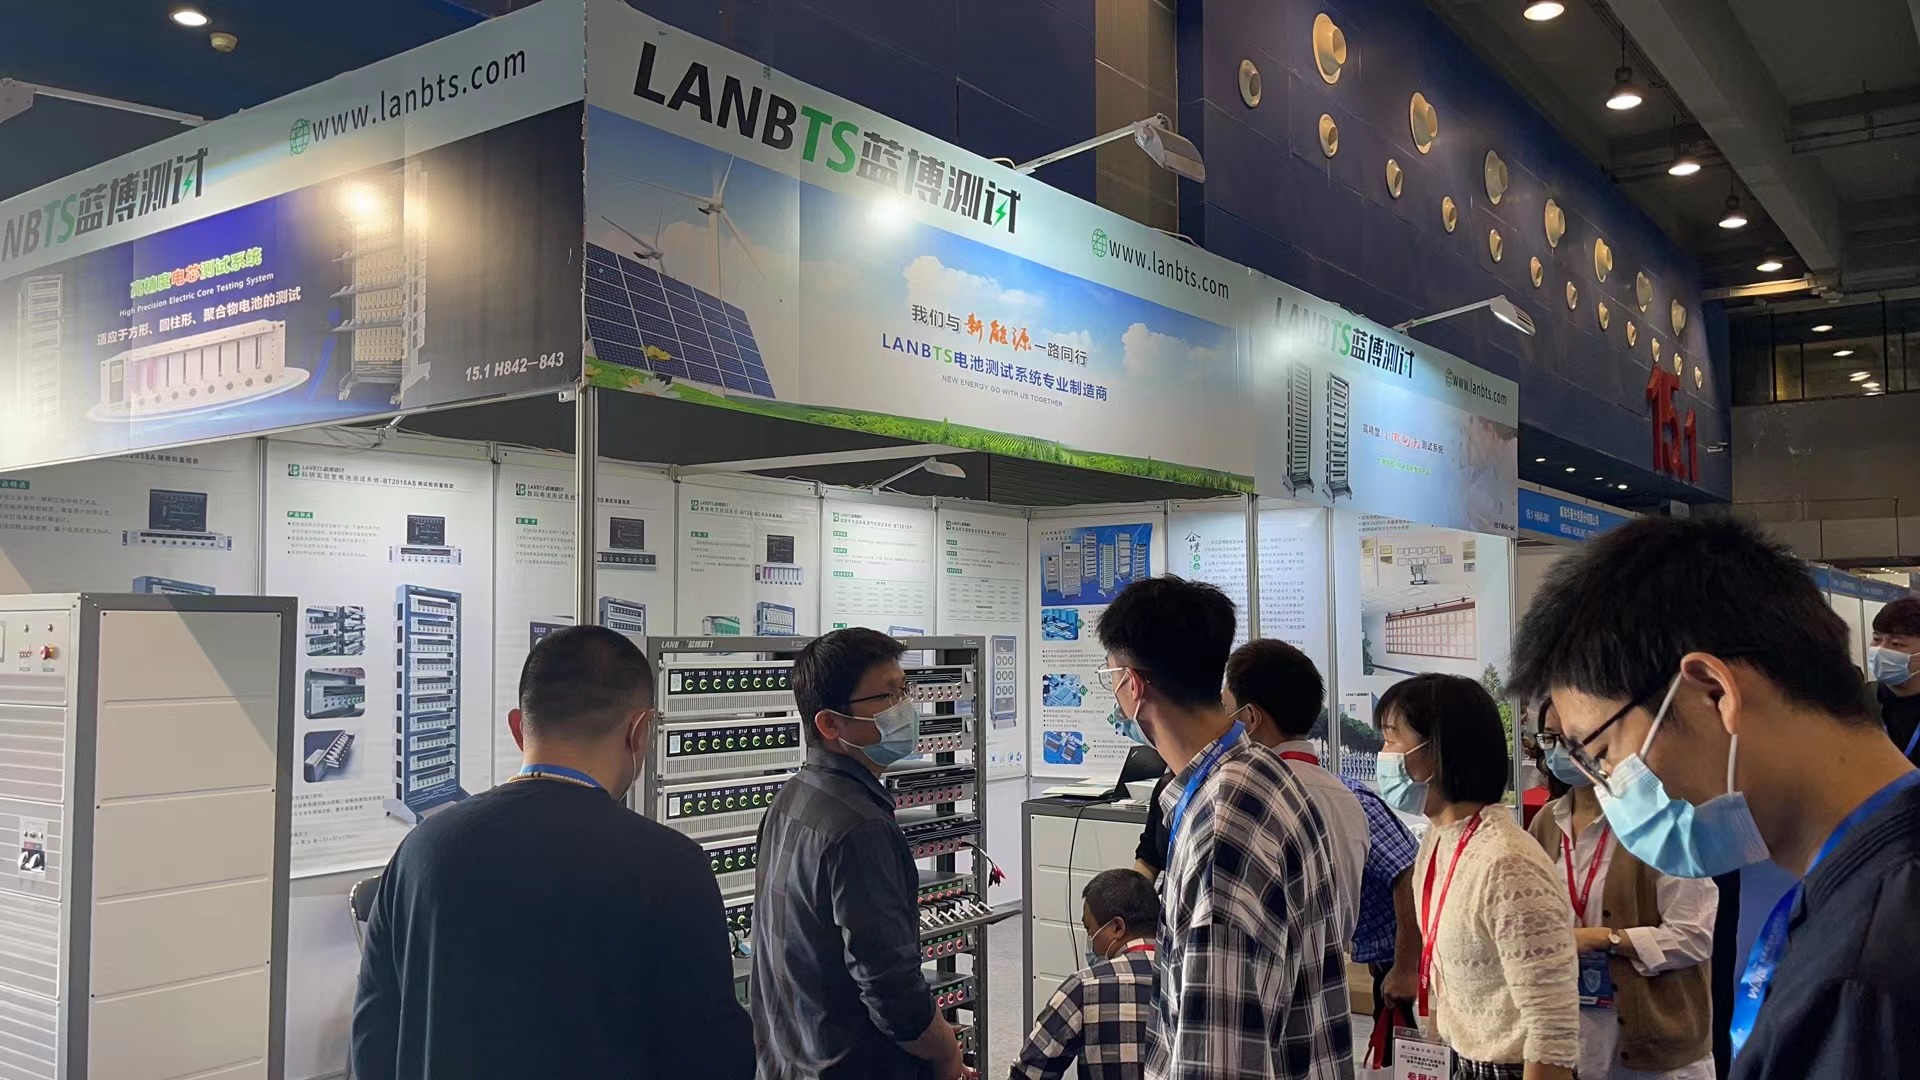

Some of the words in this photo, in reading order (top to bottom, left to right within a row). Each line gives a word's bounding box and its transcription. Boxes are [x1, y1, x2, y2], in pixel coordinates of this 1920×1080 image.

[312, 50, 526, 142] www.lanbts.com
[131, 247, 263, 298] 高精度电芯测试系统
[1109, 239, 1229, 299] www.lanbts.com
[119, 308, 136, 317] High
[137, 299, 168, 314] Precision
[169, 292, 195, 305] Electric
[197, 287, 214, 298] Core
[216, 281, 244, 295] Testing
[246, 272, 274, 286] System
[465, 364, 490, 382] 15.1
[942, 375, 959, 385] NEW
[960, 379, 989, 391] ENERGY
[990, 386, 1001, 394] GO
[1002, 388, 1019, 398] WITH
[1021, 392, 1029, 400] US
[1030, 395, 1063, 407] TOGETHER
[1452, 376, 1508, 406] www.lanbts.com
